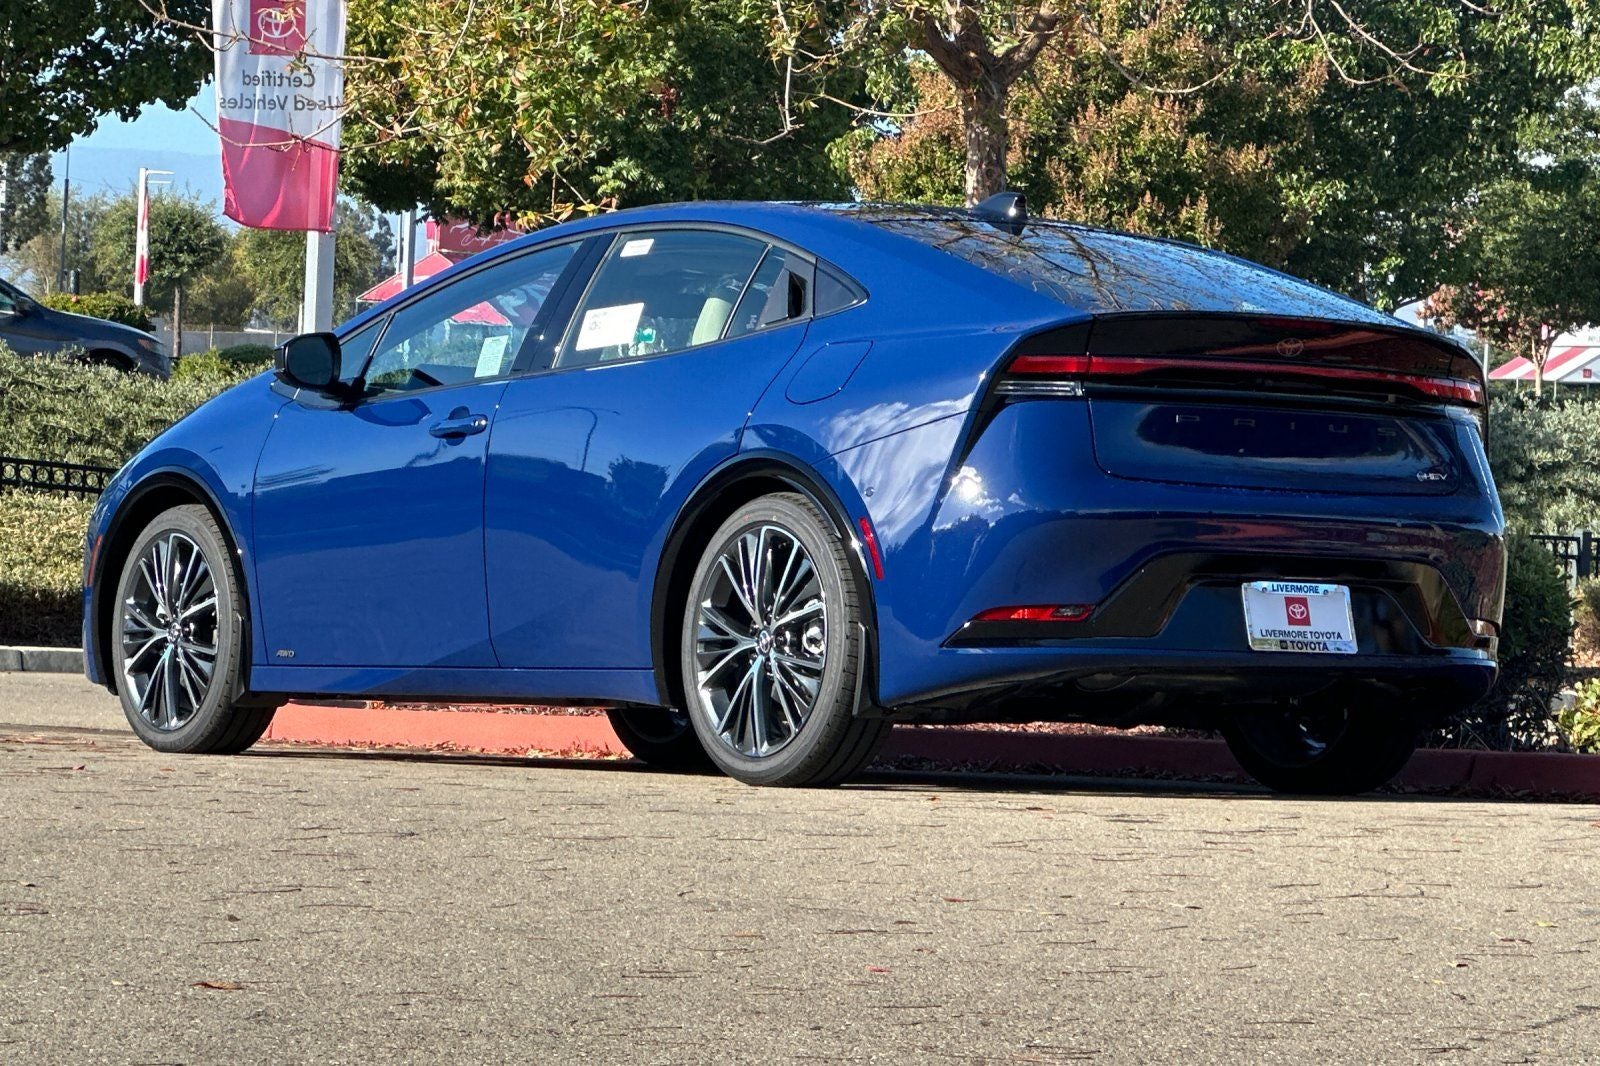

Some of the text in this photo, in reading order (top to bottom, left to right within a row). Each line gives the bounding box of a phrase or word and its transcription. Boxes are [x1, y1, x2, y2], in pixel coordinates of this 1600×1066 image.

[1176, 413, 1396, 436] PRIUS
[1271, 584, 1320, 594] LIVERMORE
[1260, 629, 1343, 640] LIVERMORE TOYOTA
[1291, 641, 1330, 652] TOYOTA
